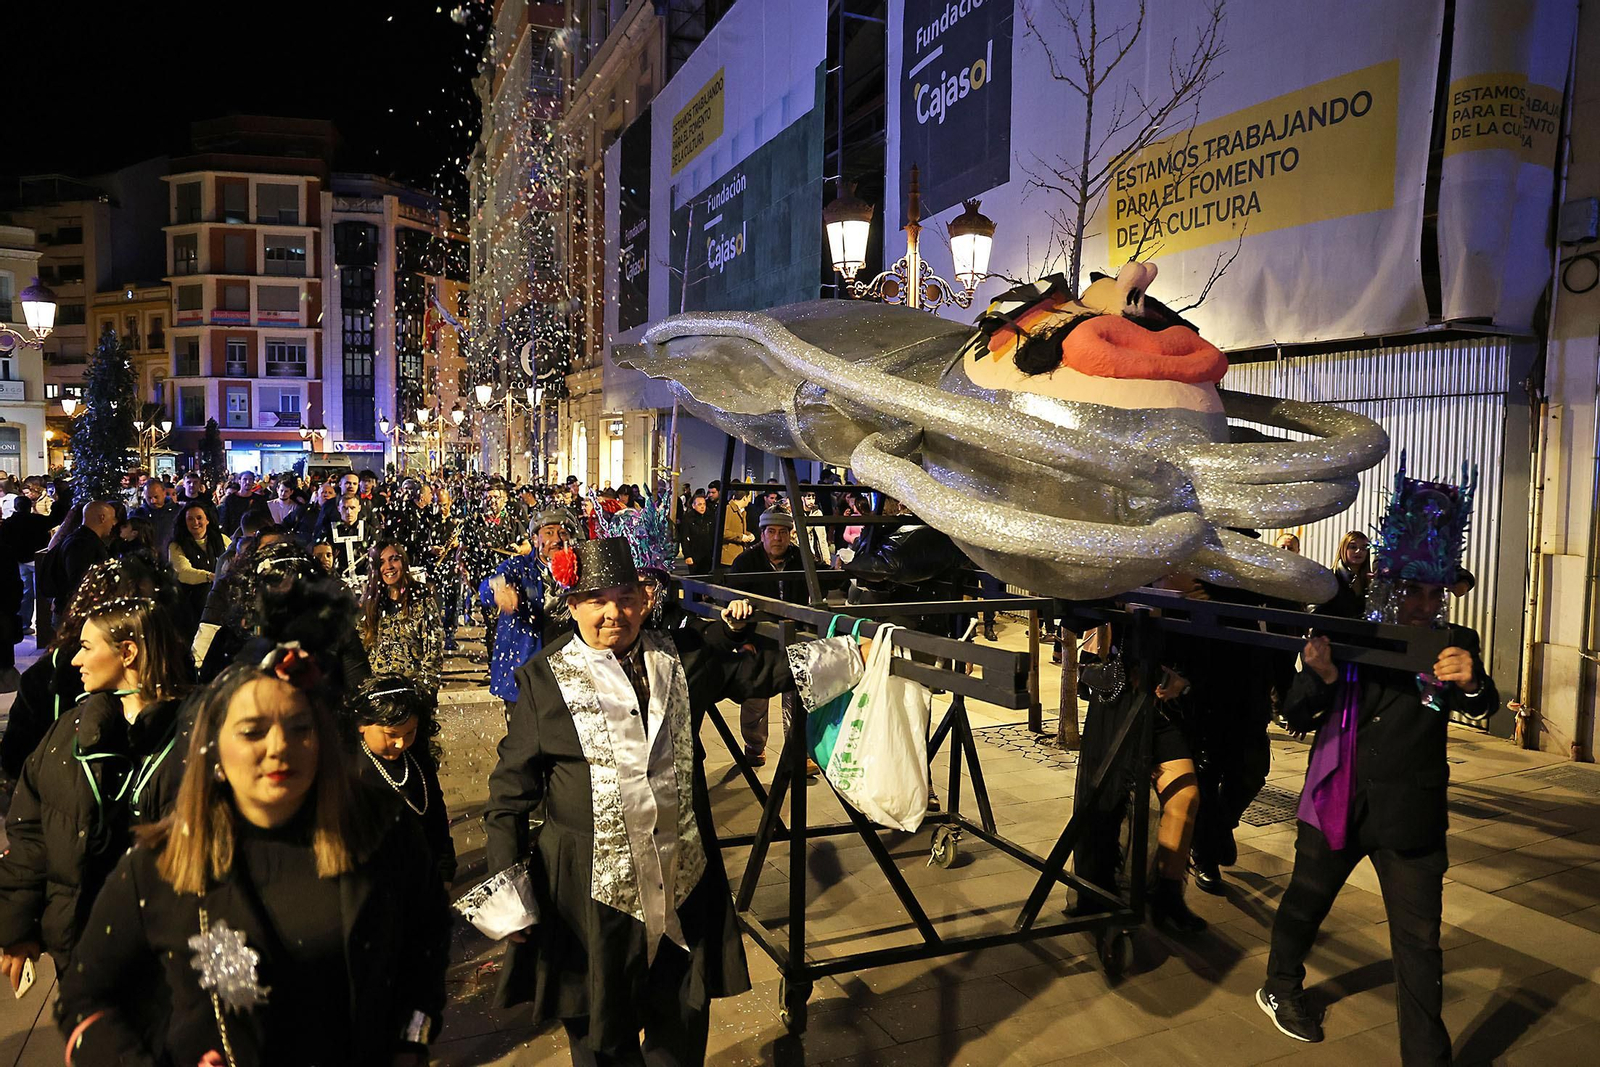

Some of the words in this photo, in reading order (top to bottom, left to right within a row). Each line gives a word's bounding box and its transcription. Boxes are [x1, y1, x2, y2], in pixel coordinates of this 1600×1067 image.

[914, 39, 993, 124] Cajasol
[1454, 86, 1526, 106] ESTAMOS
[672, 109, 692, 136] ESTAMOS
[1451, 125, 1472, 141] DE
[1476, 122, 1498, 136] LA
[1453, 104, 1495, 124] PARA
[1500, 104, 1517, 118] EL
[1116, 145, 1199, 191] ESTAMOS
[1203, 90, 1373, 162] TRABAJANDO
[707, 173, 747, 214] Fundación
[1116, 189, 1159, 220] PARA
[1163, 182, 1185, 207] EL
[1189, 146, 1300, 198] FOMENTO
[1117, 222, 1139, 248] DE
[1144, 218, 1164, 242] LA
[1166, 190, 1262, 235] CULTURA
[707, 220, 747, 273] Cajasol
